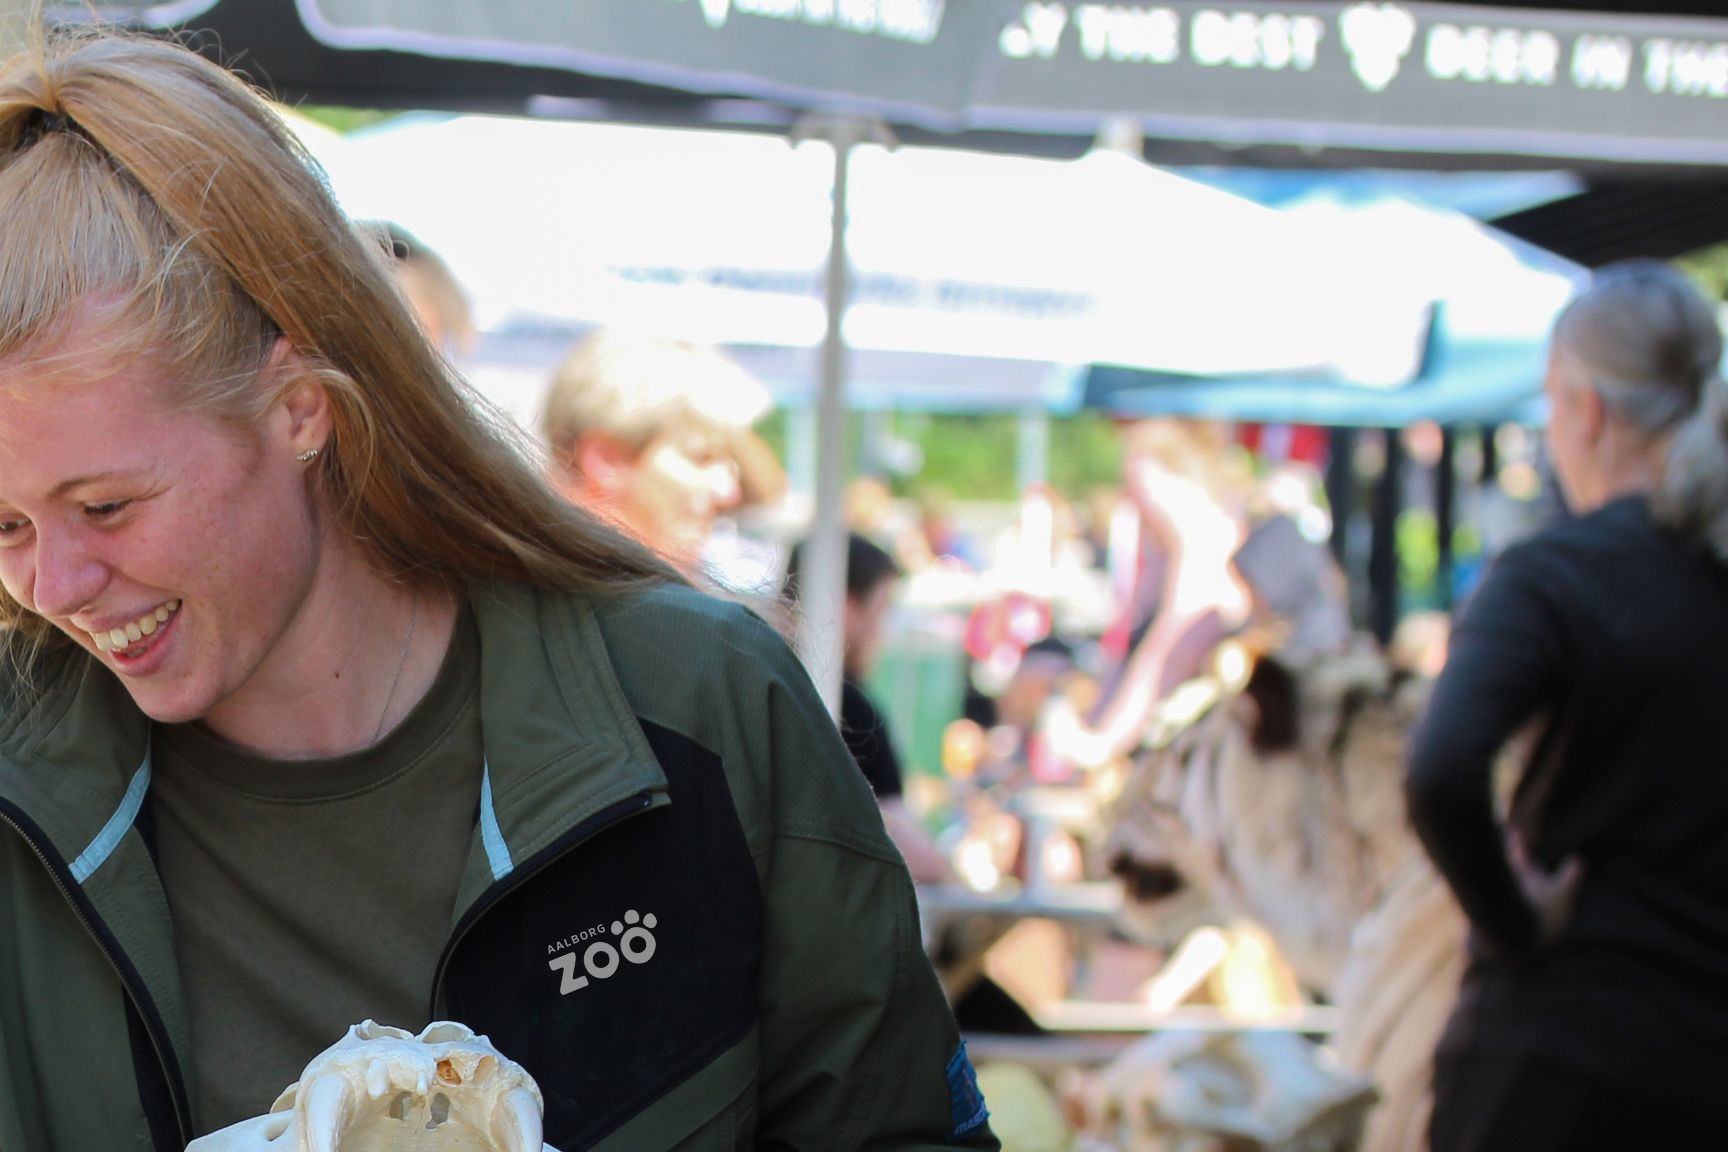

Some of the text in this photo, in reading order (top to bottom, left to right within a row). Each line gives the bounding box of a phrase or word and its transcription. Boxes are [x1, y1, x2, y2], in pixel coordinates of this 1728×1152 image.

[1076, 4, 1181, 64] THE
[1190, 9, 1324, 70] BEST
[1425, 23, 1561, 84] BEER
[1572, 36, 1633, 89] IN
[547, 923, 606, 954] AALBORG
[548, 926, 657, 995] ZOO
